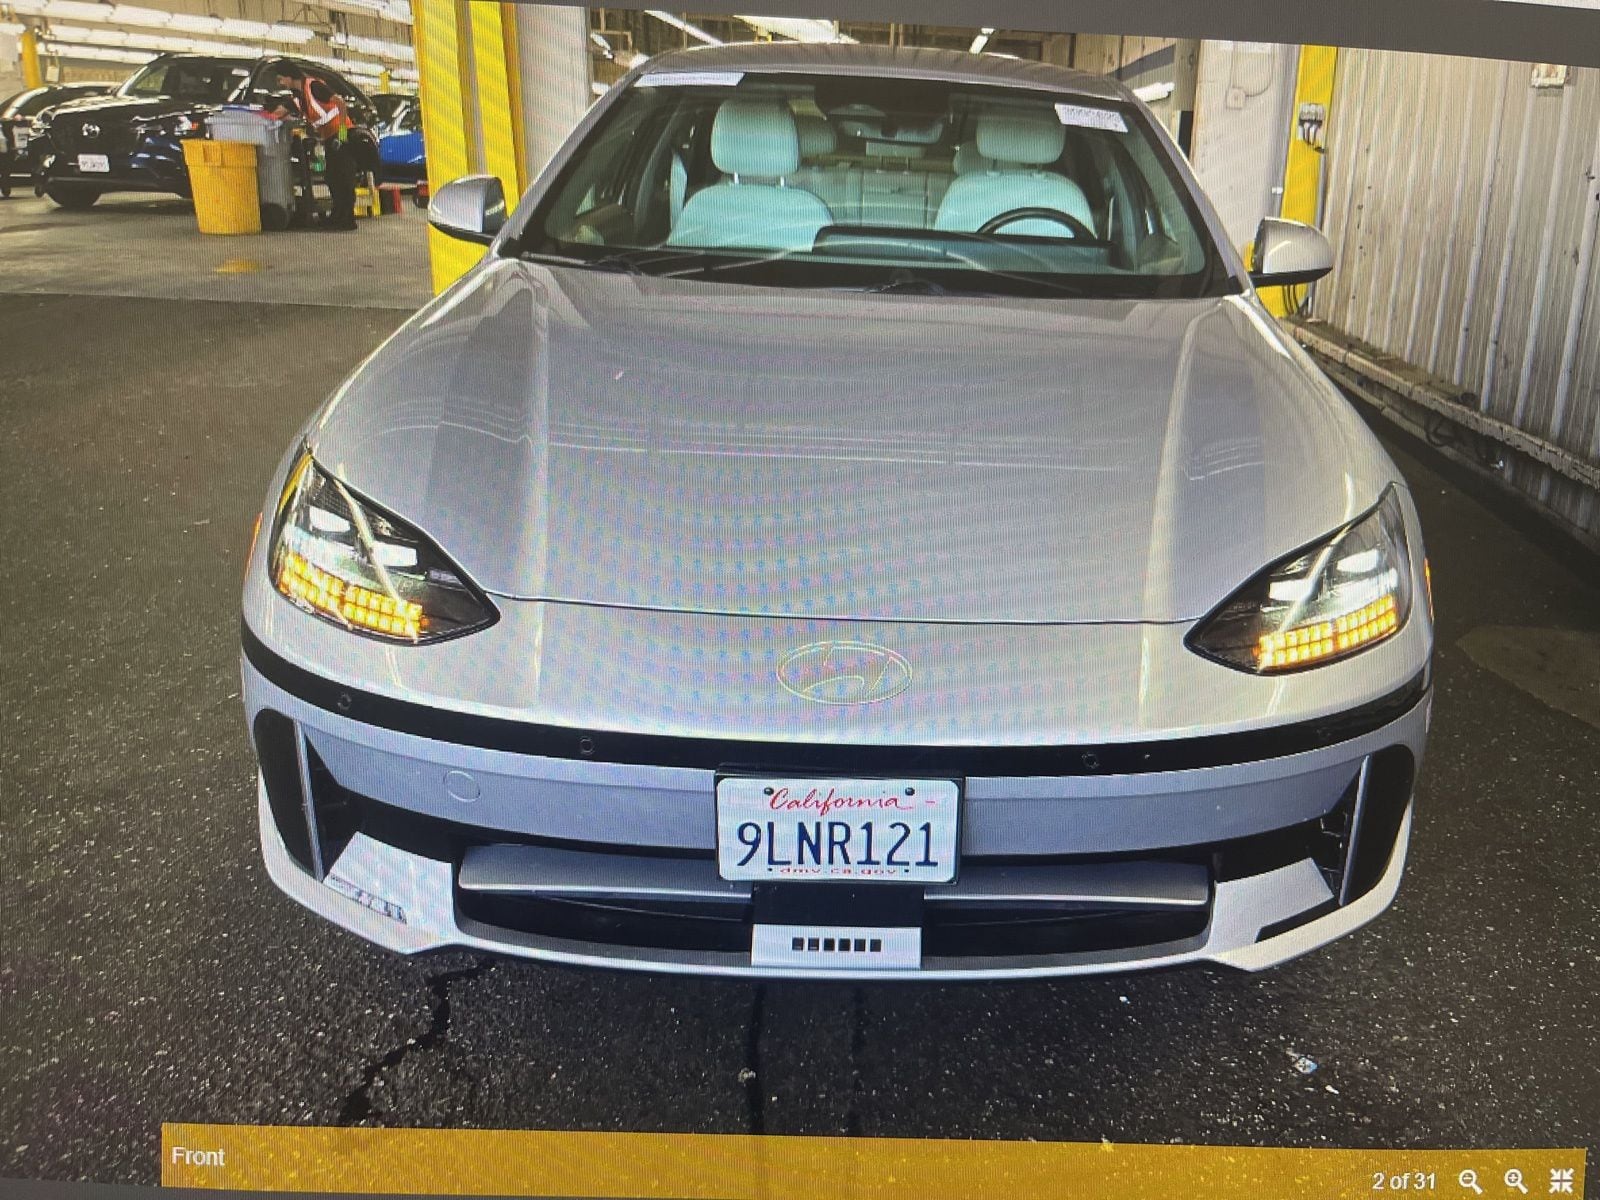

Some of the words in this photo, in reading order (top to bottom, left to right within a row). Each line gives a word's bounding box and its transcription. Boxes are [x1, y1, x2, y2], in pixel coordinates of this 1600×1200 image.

[769, 787, 914, 816] California
[737, 821, 939, 867] 9LNR121
[172, 1147, 225, 1166] Front
[1372, 1172, 1386, 1190] 2
[1389, 1172, 1411, 1190] of
[1414, 1172, 1436, 1190] 31
